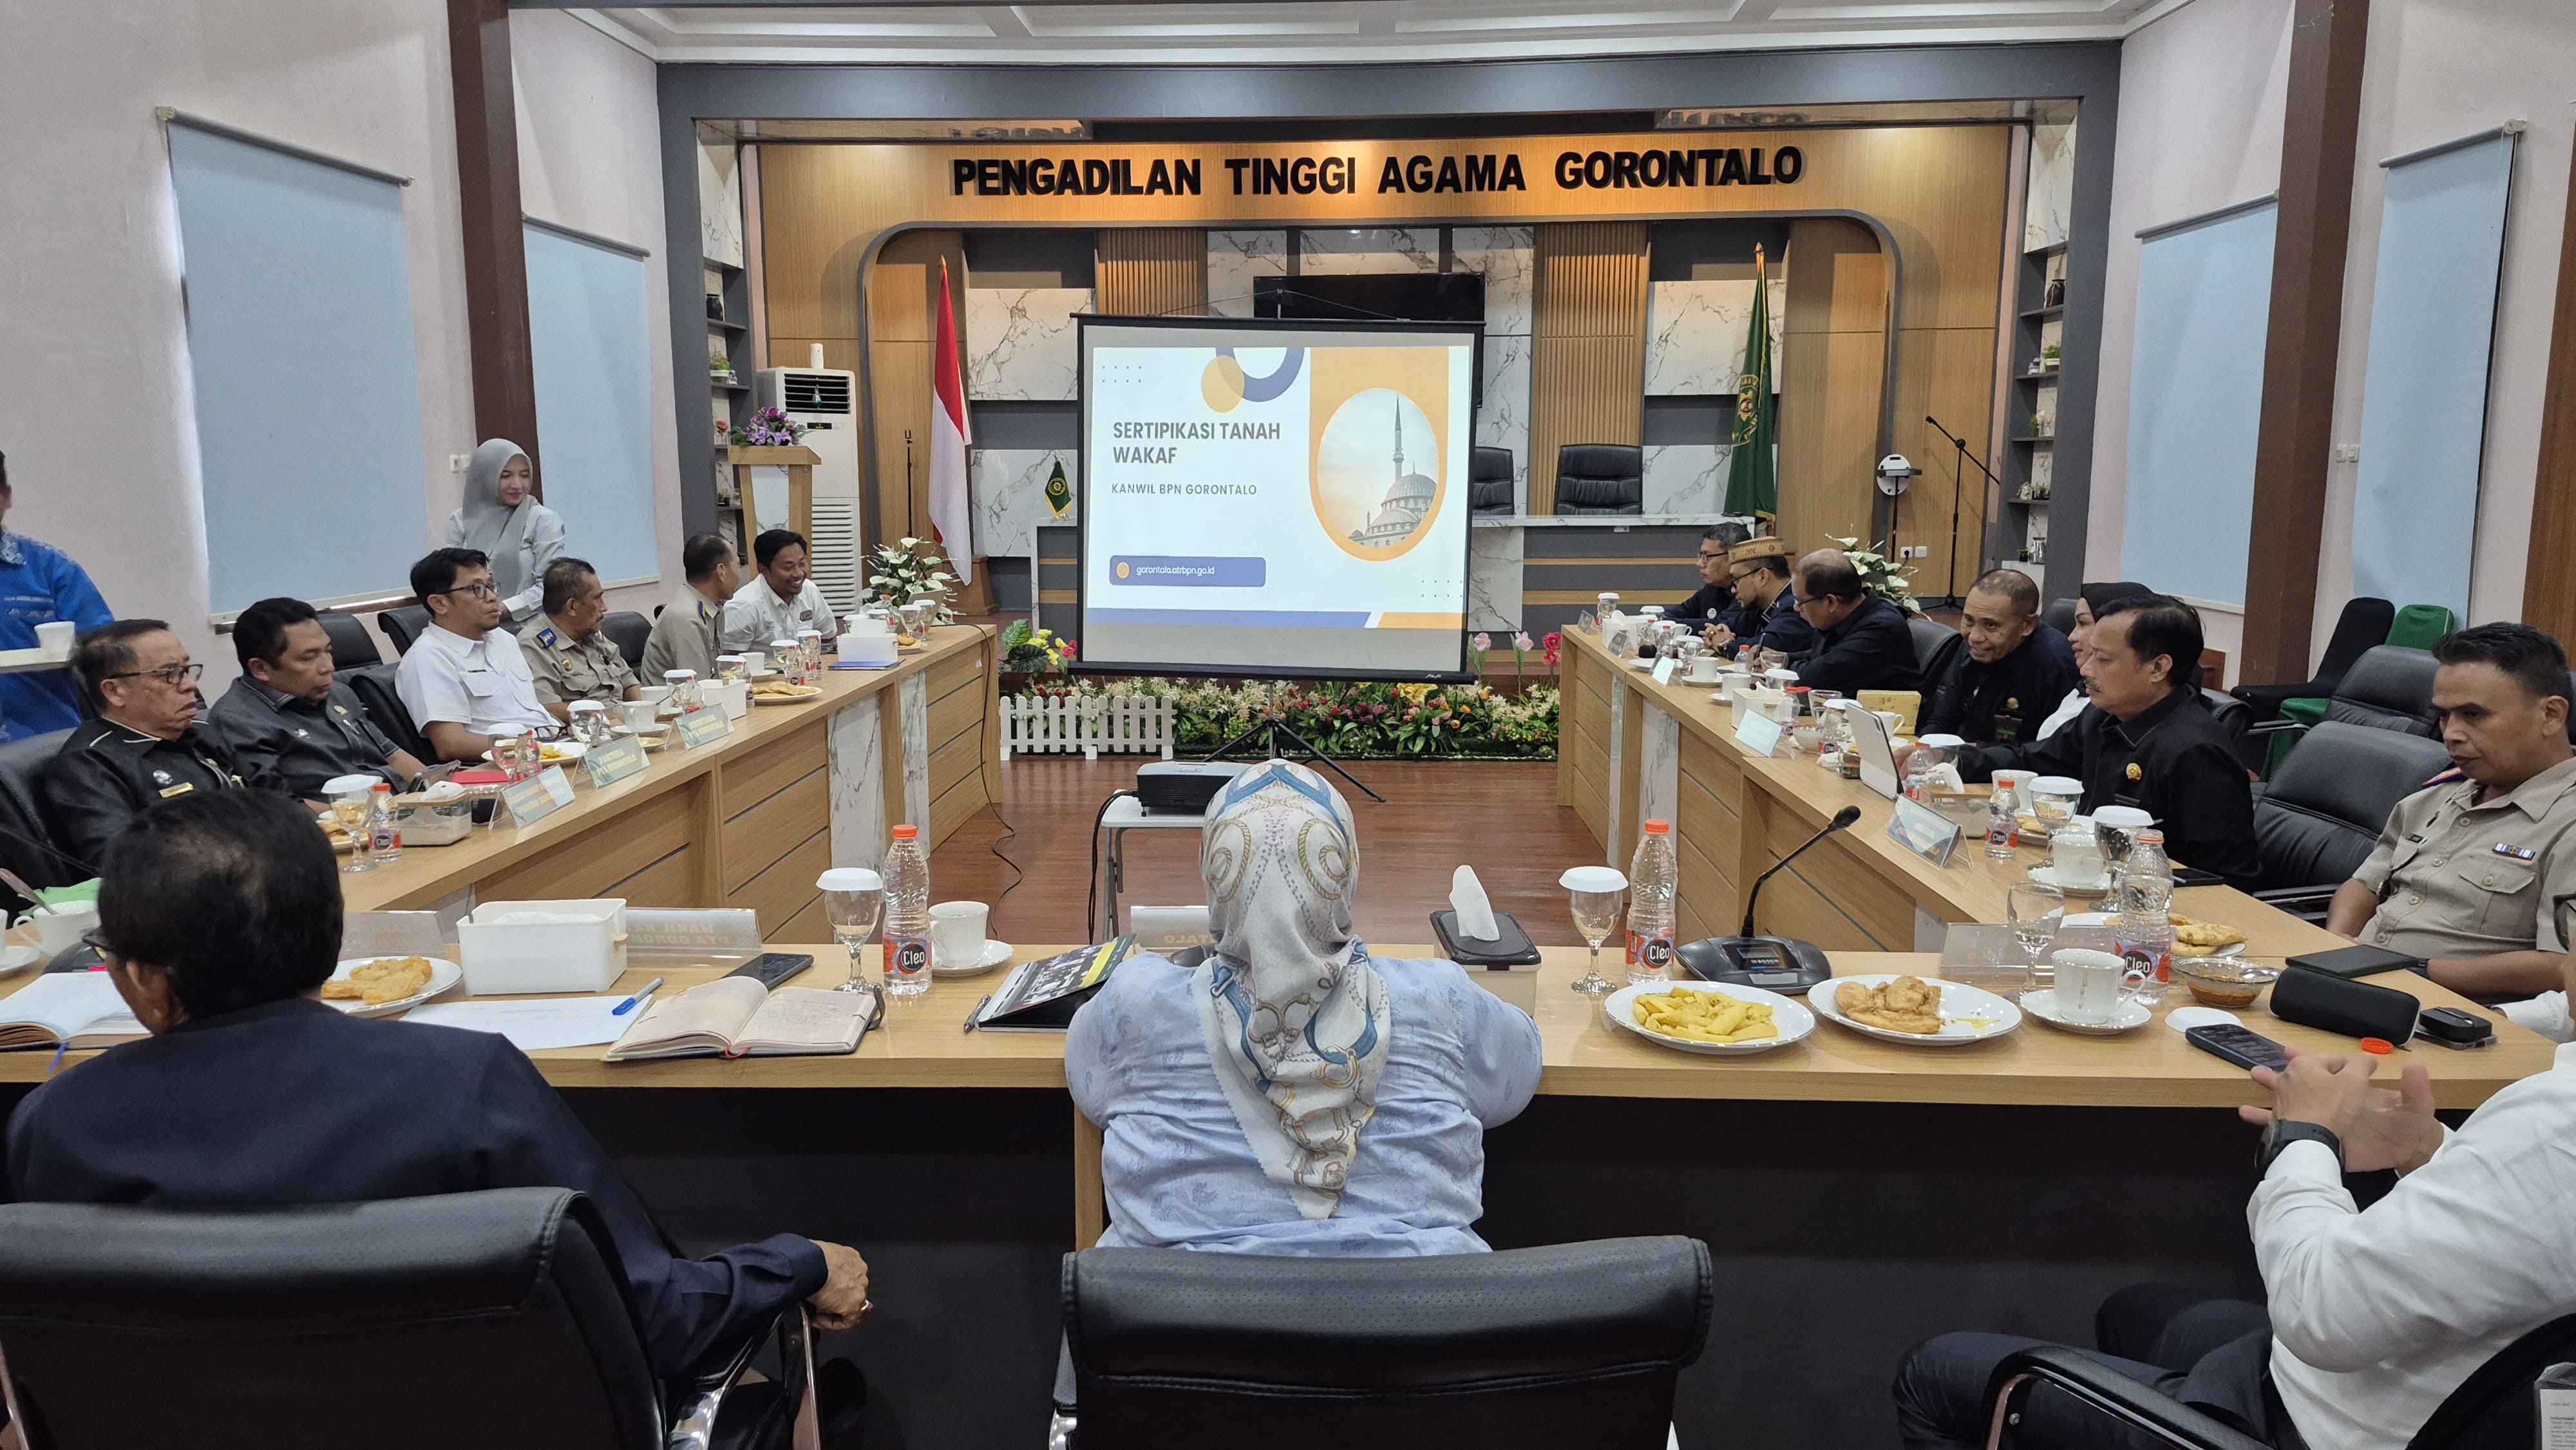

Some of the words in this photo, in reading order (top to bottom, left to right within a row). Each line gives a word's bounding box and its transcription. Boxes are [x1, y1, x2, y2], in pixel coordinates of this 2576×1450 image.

[953, 158, 1201, 196] PENGADILAN
[1224, 156, 1356, 195] TINGGI
[1378, 155, 1526, 193] AGAMA
[1555, 146, 1803, 189] GORONTALO
[1113, 422, 1215, 439] SERTIPIKASI
[1219, 422, 1280, 440] TANAH
[1113, 446, 1177, 464] WAKAF
[1112, 483, 1155, 494] KANWIL
[1159, 484, 1182, 494] BPN
[1186, 484, 1256, 495] GORONTALO
[1136, 565, 1215, 577] gorontalo.atrbpn.go.id
[903, 950, 925, 965] Cleo
[1649, 945, 1671, 960] Cleo
[2125, 956, 2151, 974] Cleo
